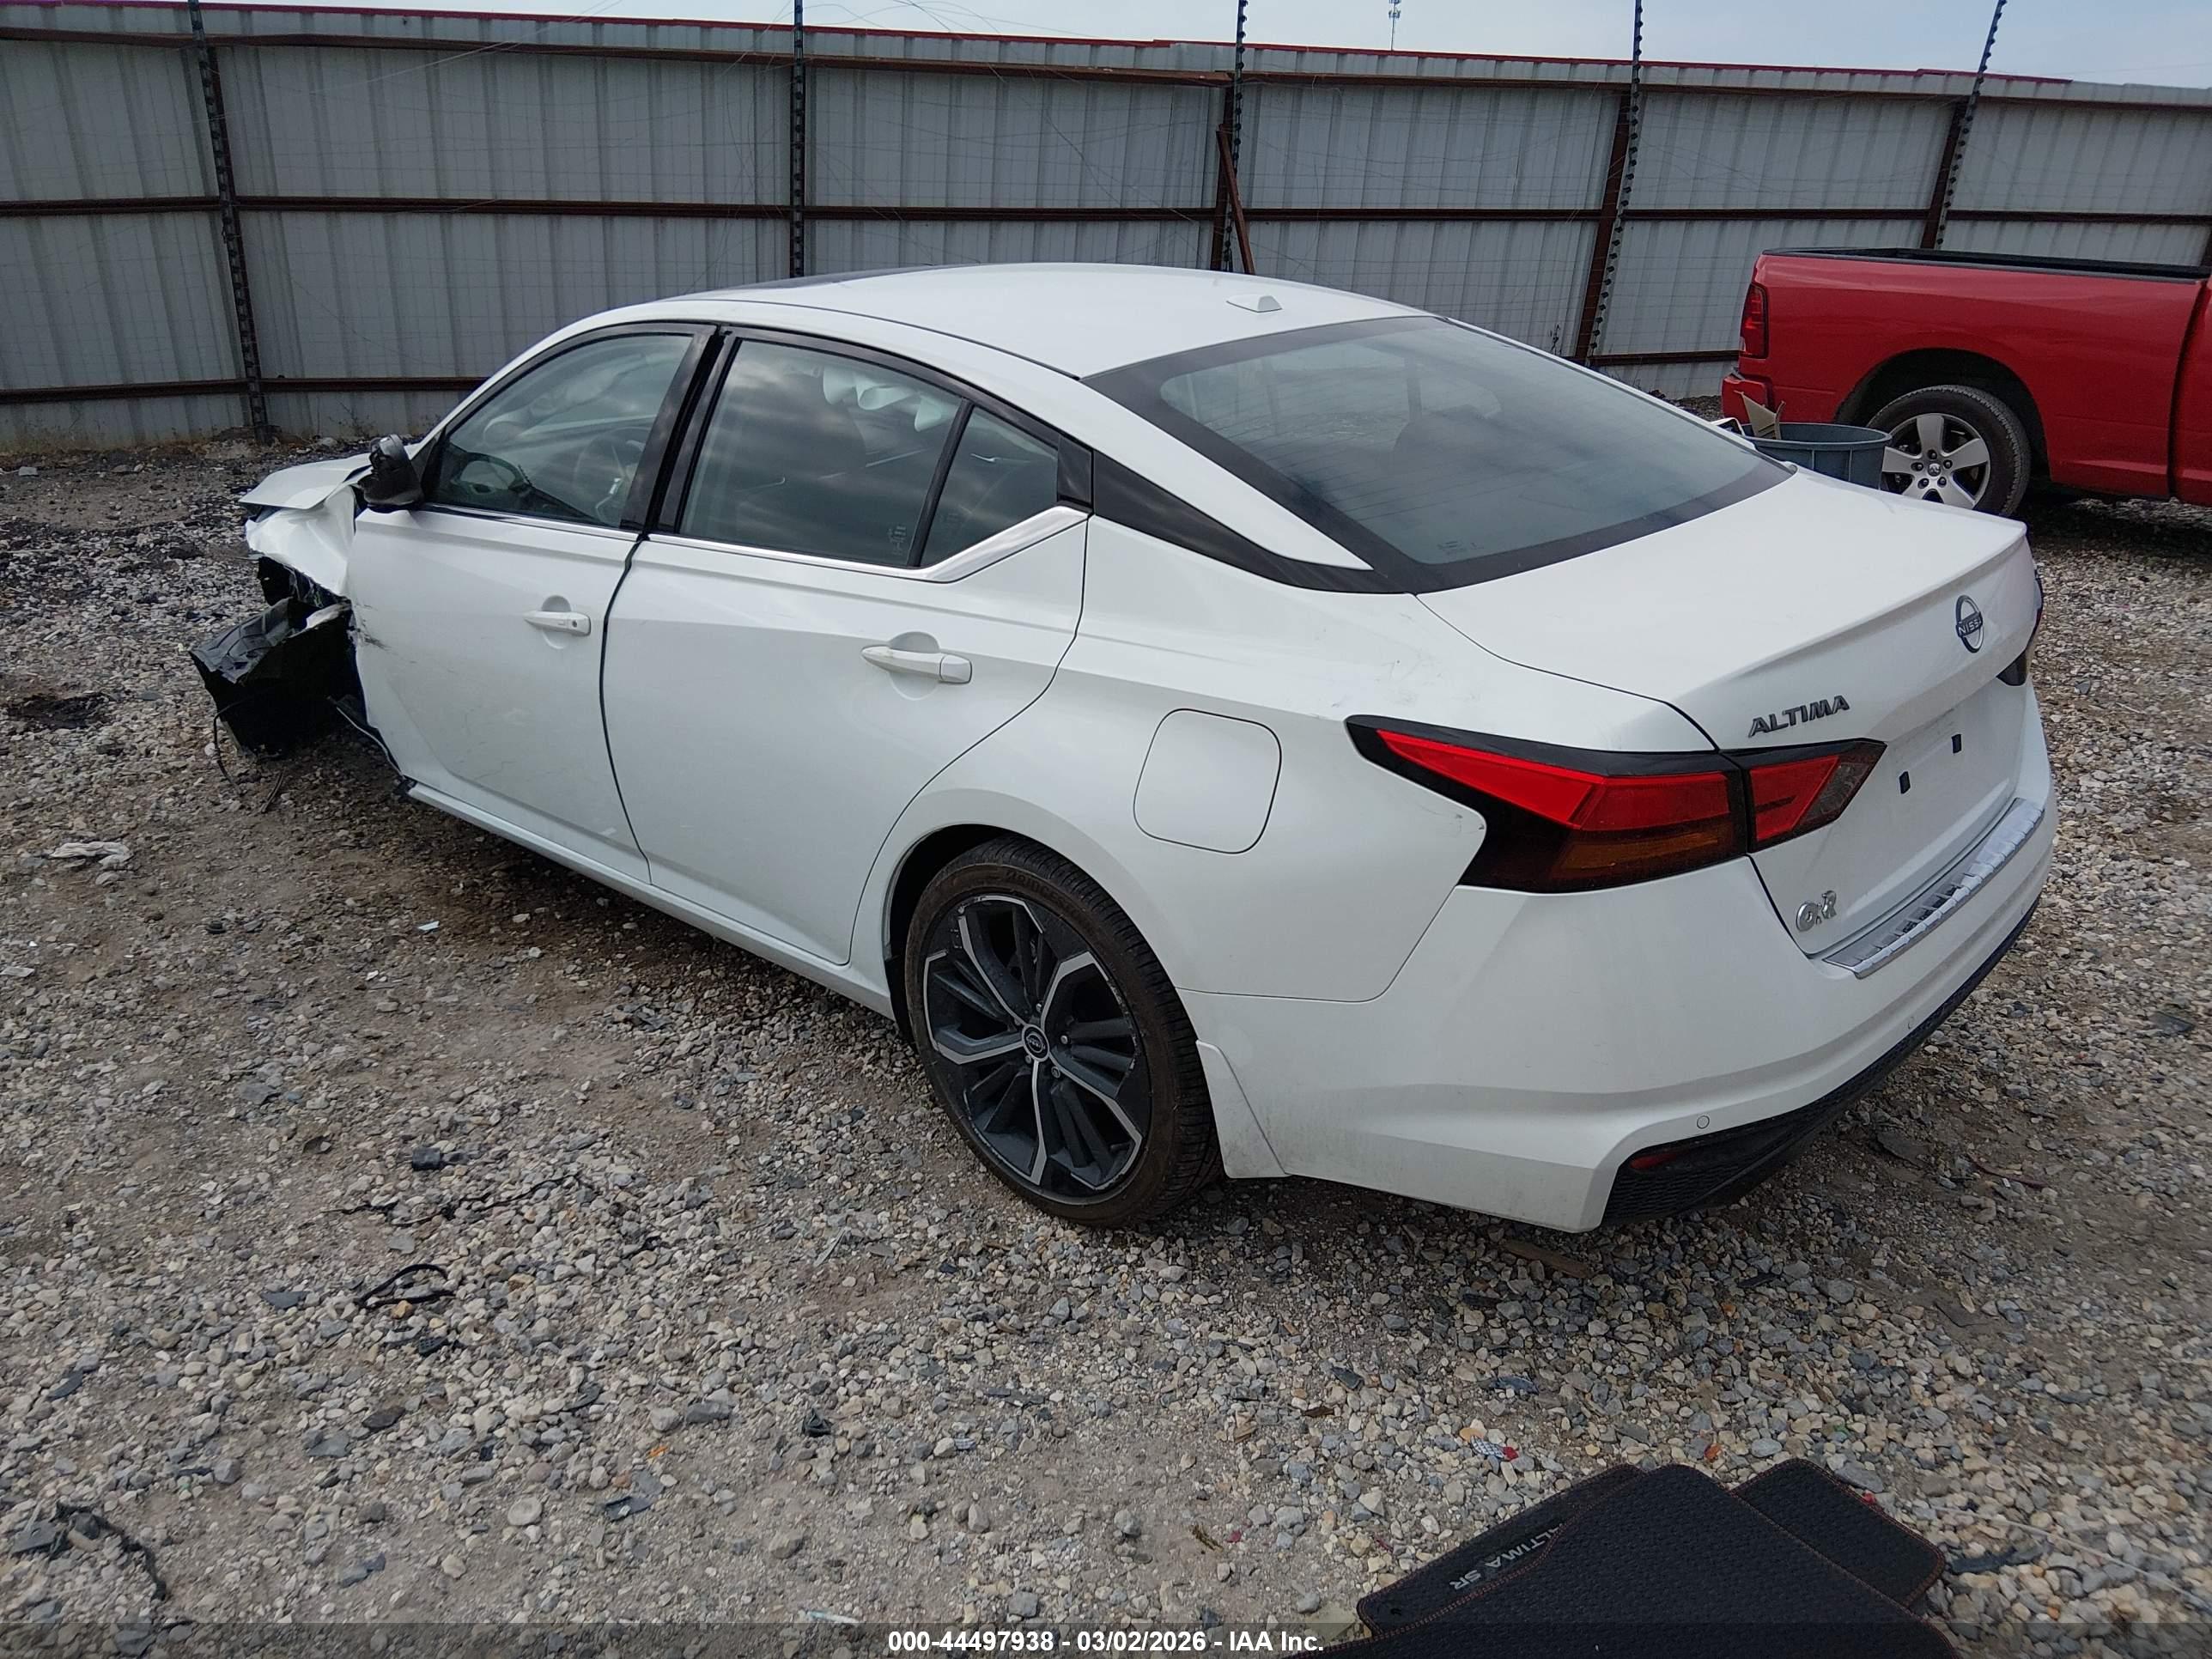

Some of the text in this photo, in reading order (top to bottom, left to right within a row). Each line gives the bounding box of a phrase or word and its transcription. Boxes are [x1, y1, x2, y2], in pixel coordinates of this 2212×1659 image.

[1958, 618, 1983, 635] NISS
[1748, 695, 1850, 738] ALTIMA
[1449, 1569, 1482, 1590] SR
